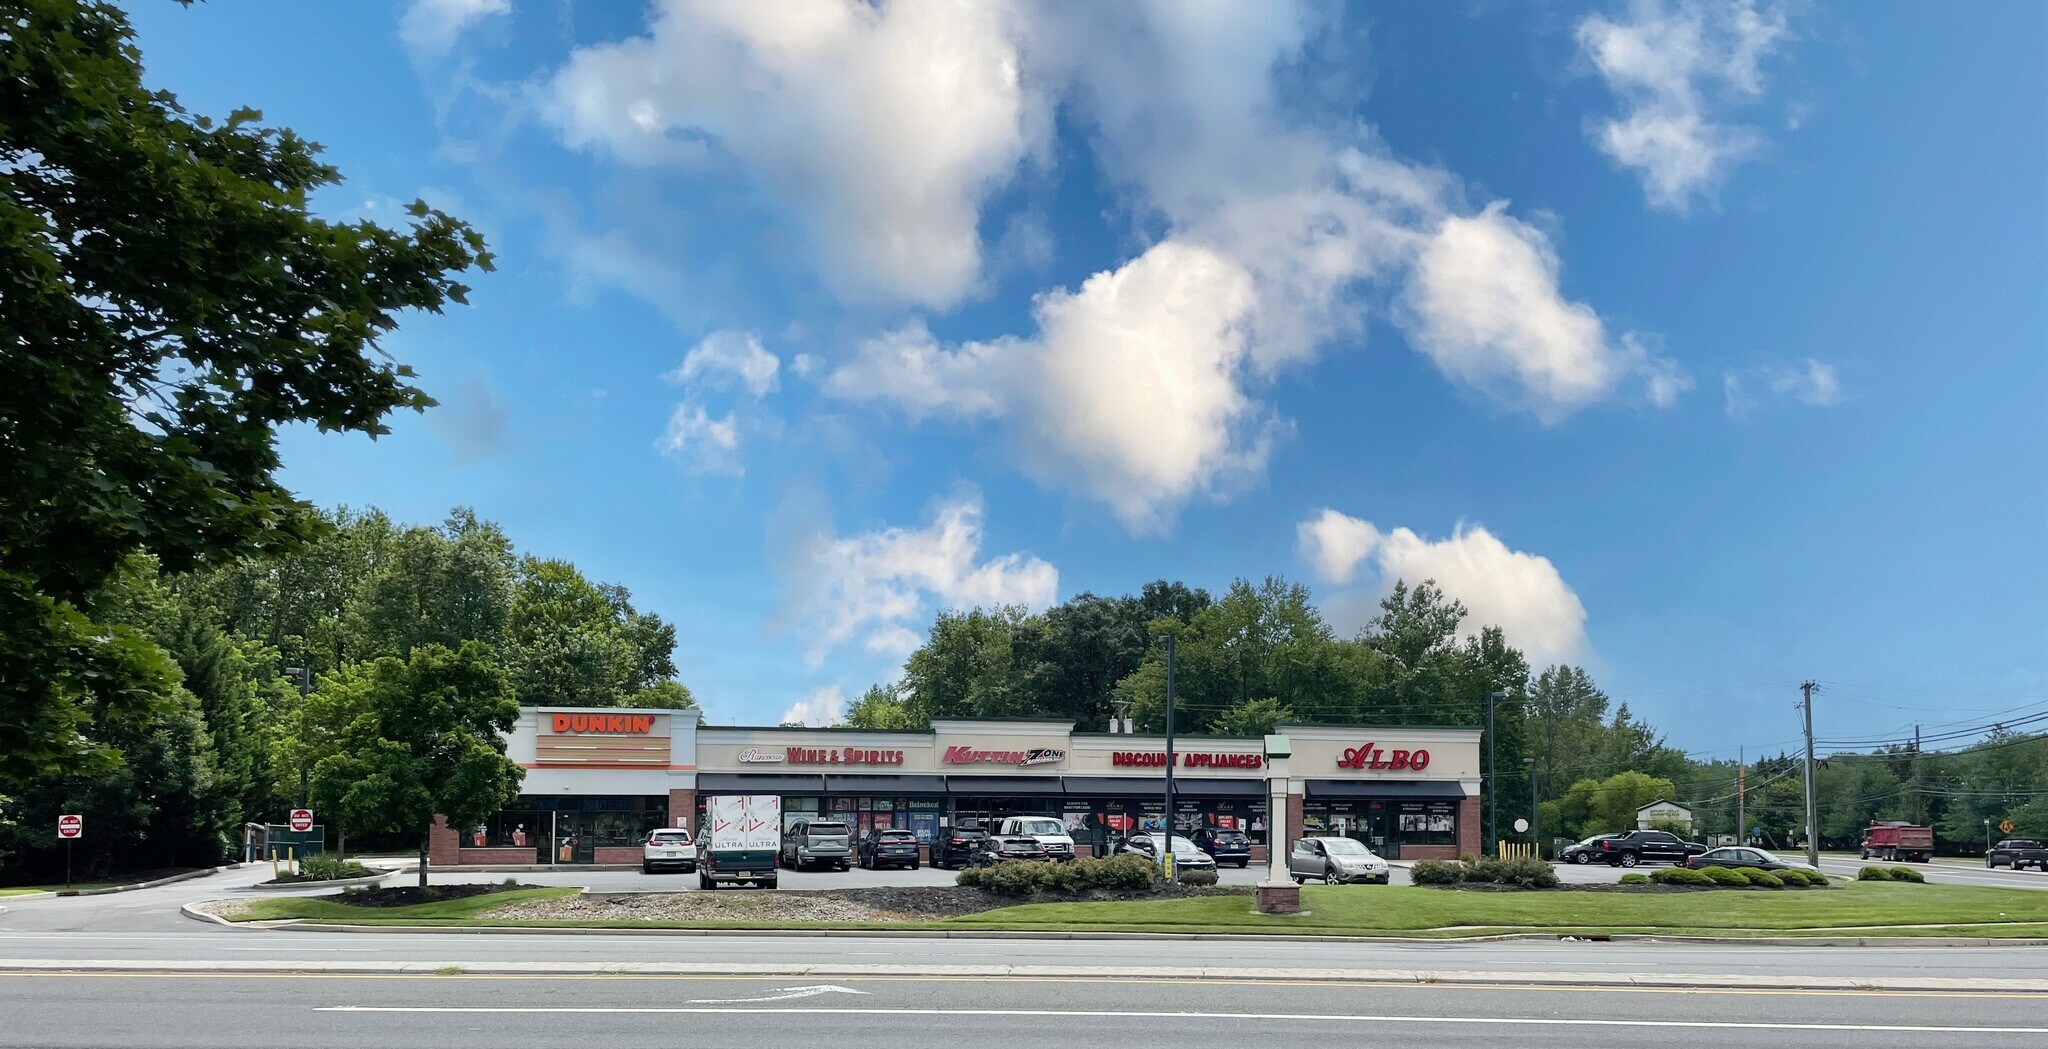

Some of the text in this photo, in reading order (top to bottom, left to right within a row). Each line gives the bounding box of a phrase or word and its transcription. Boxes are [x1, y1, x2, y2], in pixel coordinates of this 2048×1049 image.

[553, 713, 656, 734] DUNKIN'
[787, 747, 904, 765] WINE & SPIRITS
[942, 746, 1064, 766] KUTTIN ZONE
[1112, 752, 1262, 768] DISCOUNT APPLIANCES
[1337, 742, 1431, 771] ALBO
